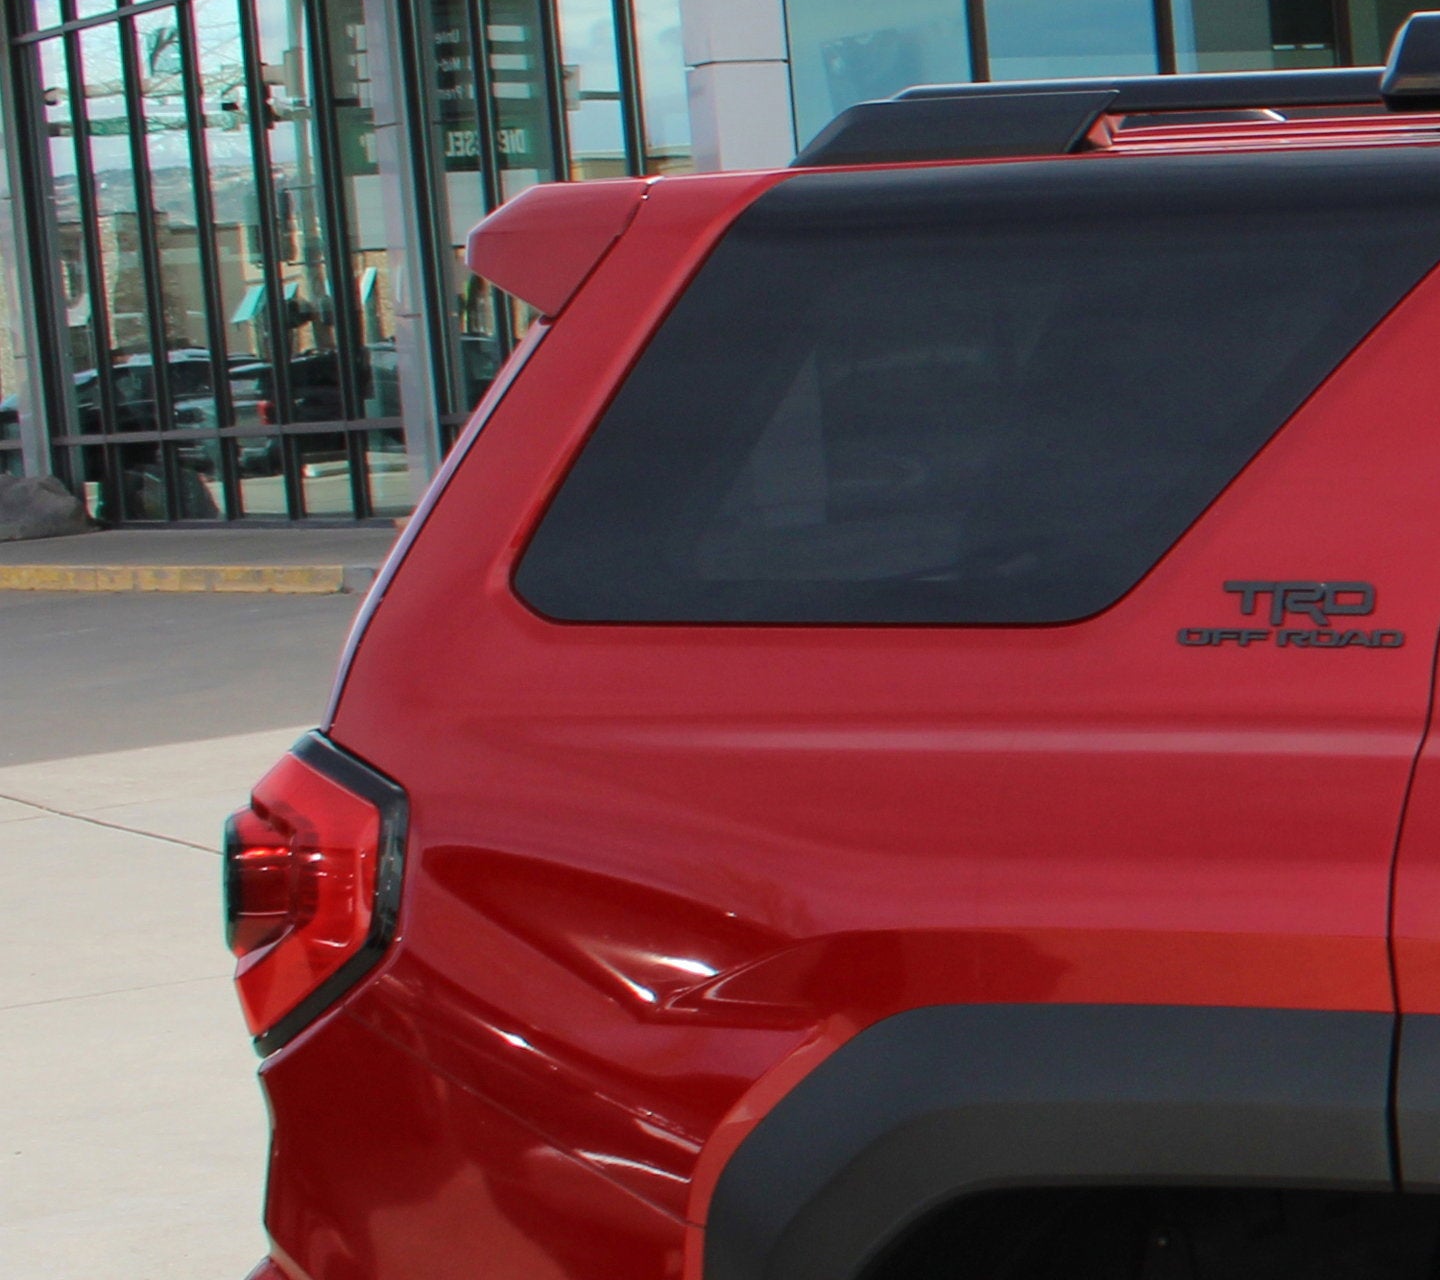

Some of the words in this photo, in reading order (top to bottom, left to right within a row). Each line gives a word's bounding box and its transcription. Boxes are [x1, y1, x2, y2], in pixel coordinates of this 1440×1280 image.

[1222, 580, 1375, 626] TRD
[1177, 627, 1271, 648] OFF
[1276, 628, 1405, 649] ROAD
